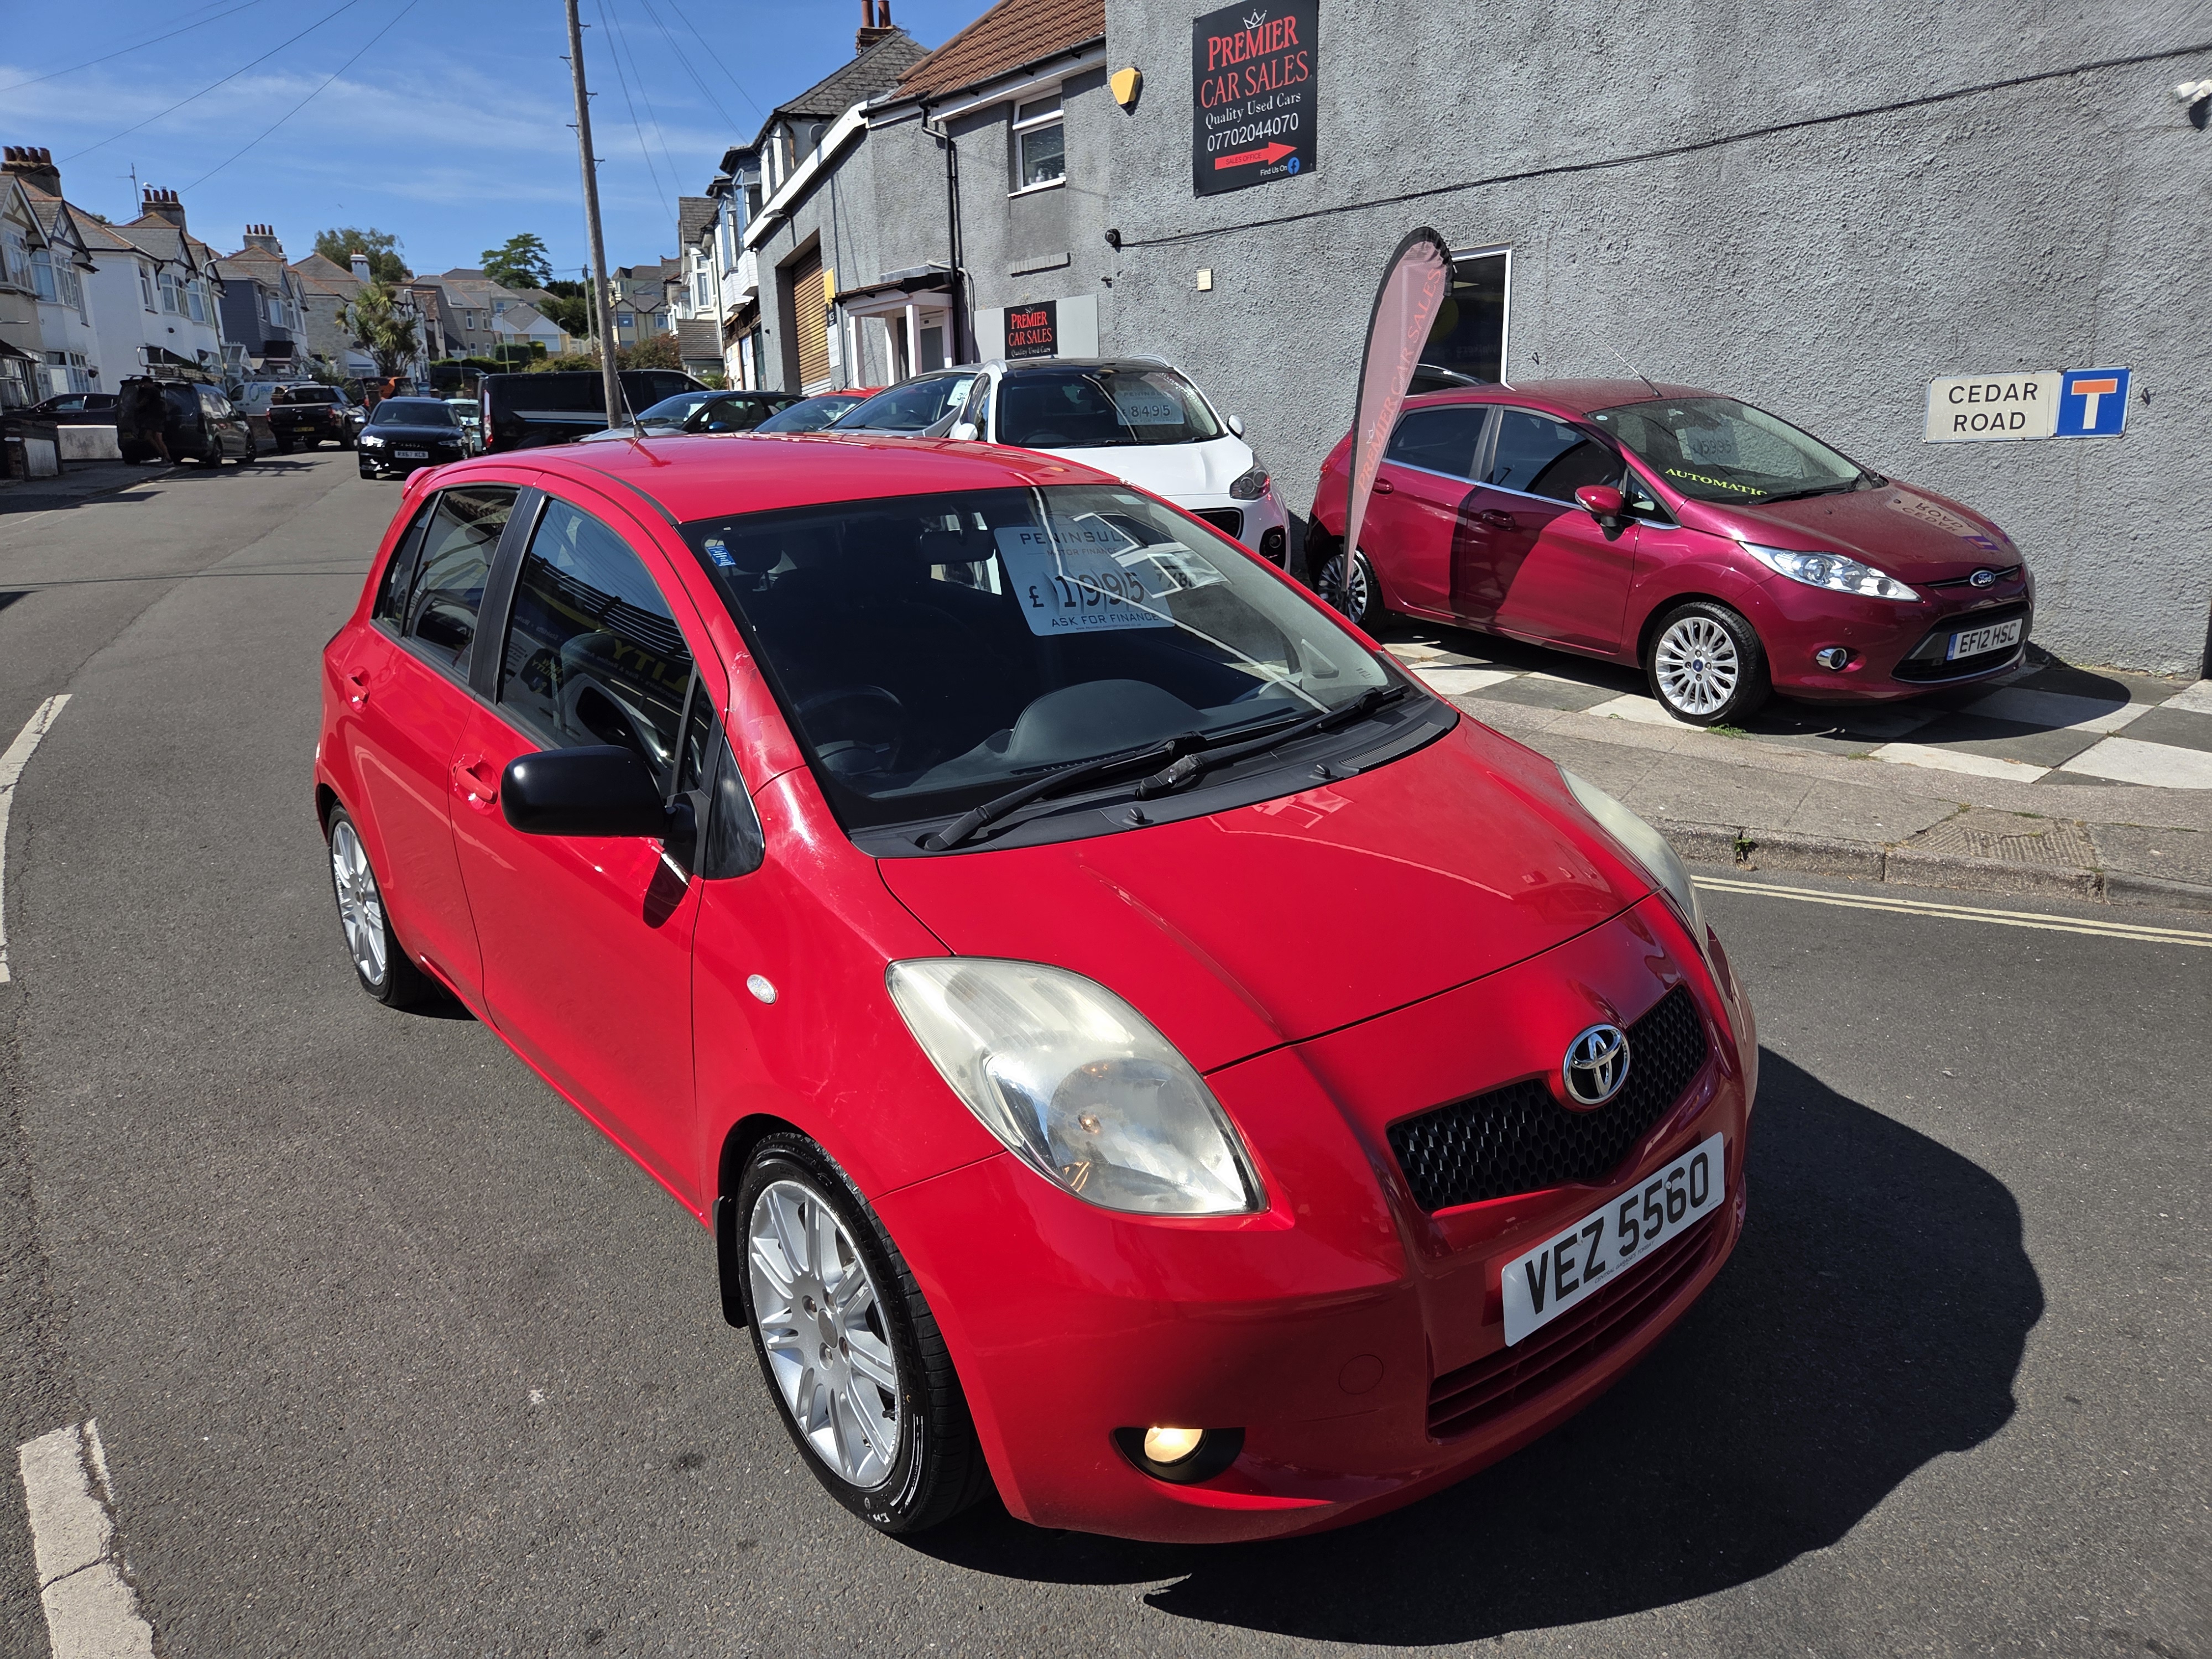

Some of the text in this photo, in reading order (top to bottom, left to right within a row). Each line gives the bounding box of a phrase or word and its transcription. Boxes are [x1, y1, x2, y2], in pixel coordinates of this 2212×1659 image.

[1208, 15, 1298, 71] PREMIER
[1201, 50, 1310, 108] CAR SALES
[1205, 92, 1301, 129] Quality Used Cars
[1207, 112, 1298, 152] 07702044070
[1225, 152, 1262, 165] SALES OFFICE
[1260, 168, 1271, 176] Find
[1011, 311, 1047, 330] PREMIER
[1008, 327, 1052, 347] CAR SALES
[1011, 348, 1027, 358] Quality
[1358, 268, 1442, 496] PREMIER CAR SALES
[1948, 382, 2038, 405] CEDAR
[1131, 405, 1171, 418] 8495
[1953, 411, 2026, 432] ROAD
[1029, 572, 1146, 609] £ 1995
[1052, 612, 1160, 627] ASK FOR FINANCE
[1959, 623, 2017, 654] EF12 HSC
[1525, 1151, 1709, 1315] VEZ 5560
